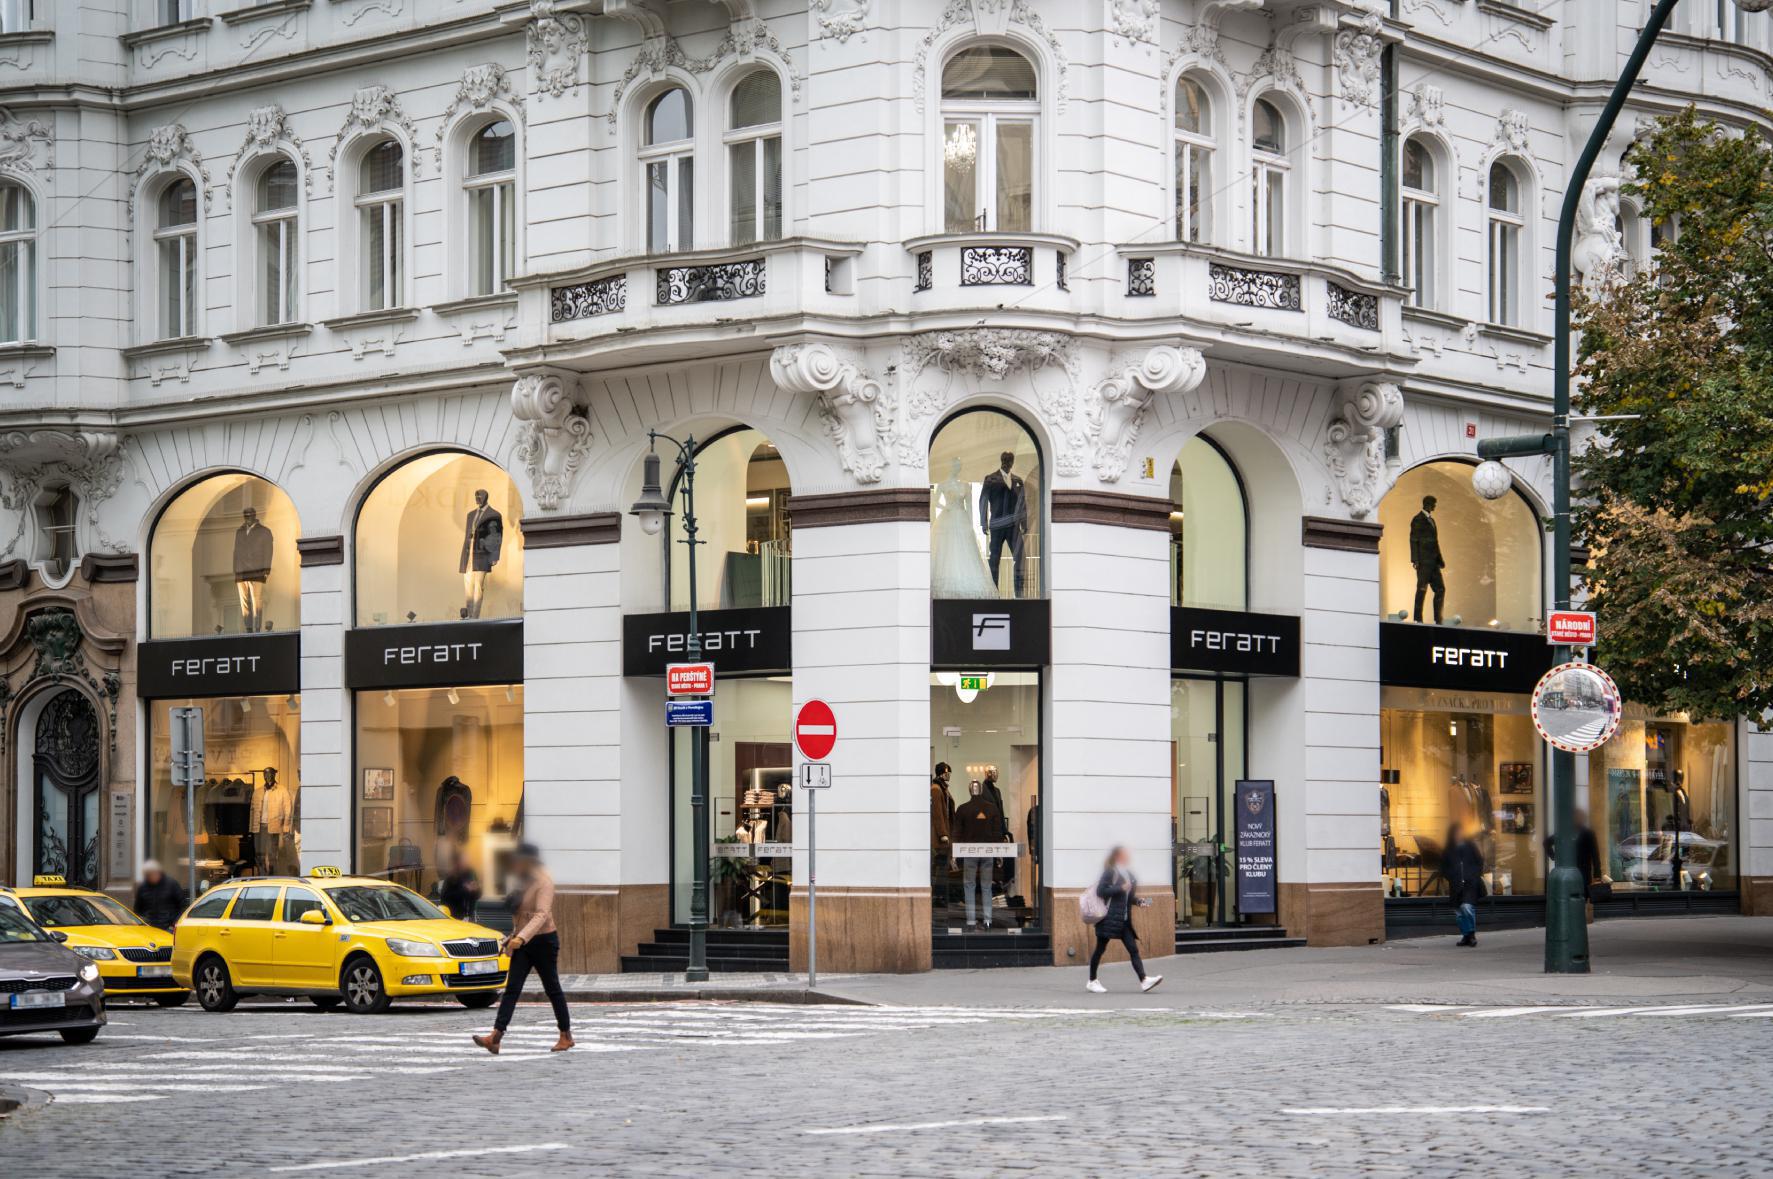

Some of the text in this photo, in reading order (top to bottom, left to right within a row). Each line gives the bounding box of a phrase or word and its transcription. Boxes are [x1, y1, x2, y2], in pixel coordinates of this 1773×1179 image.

[1556, 618, 1590, 631] NÁRODNÍ
[671, 670, 707, 682] NA PERŠTÝNĚ
[1248, 822, 1262, 830] NOVÝ
[1253, 862, 1272, 870] ČLENY
[317, 867, 341, 876] TAXI
